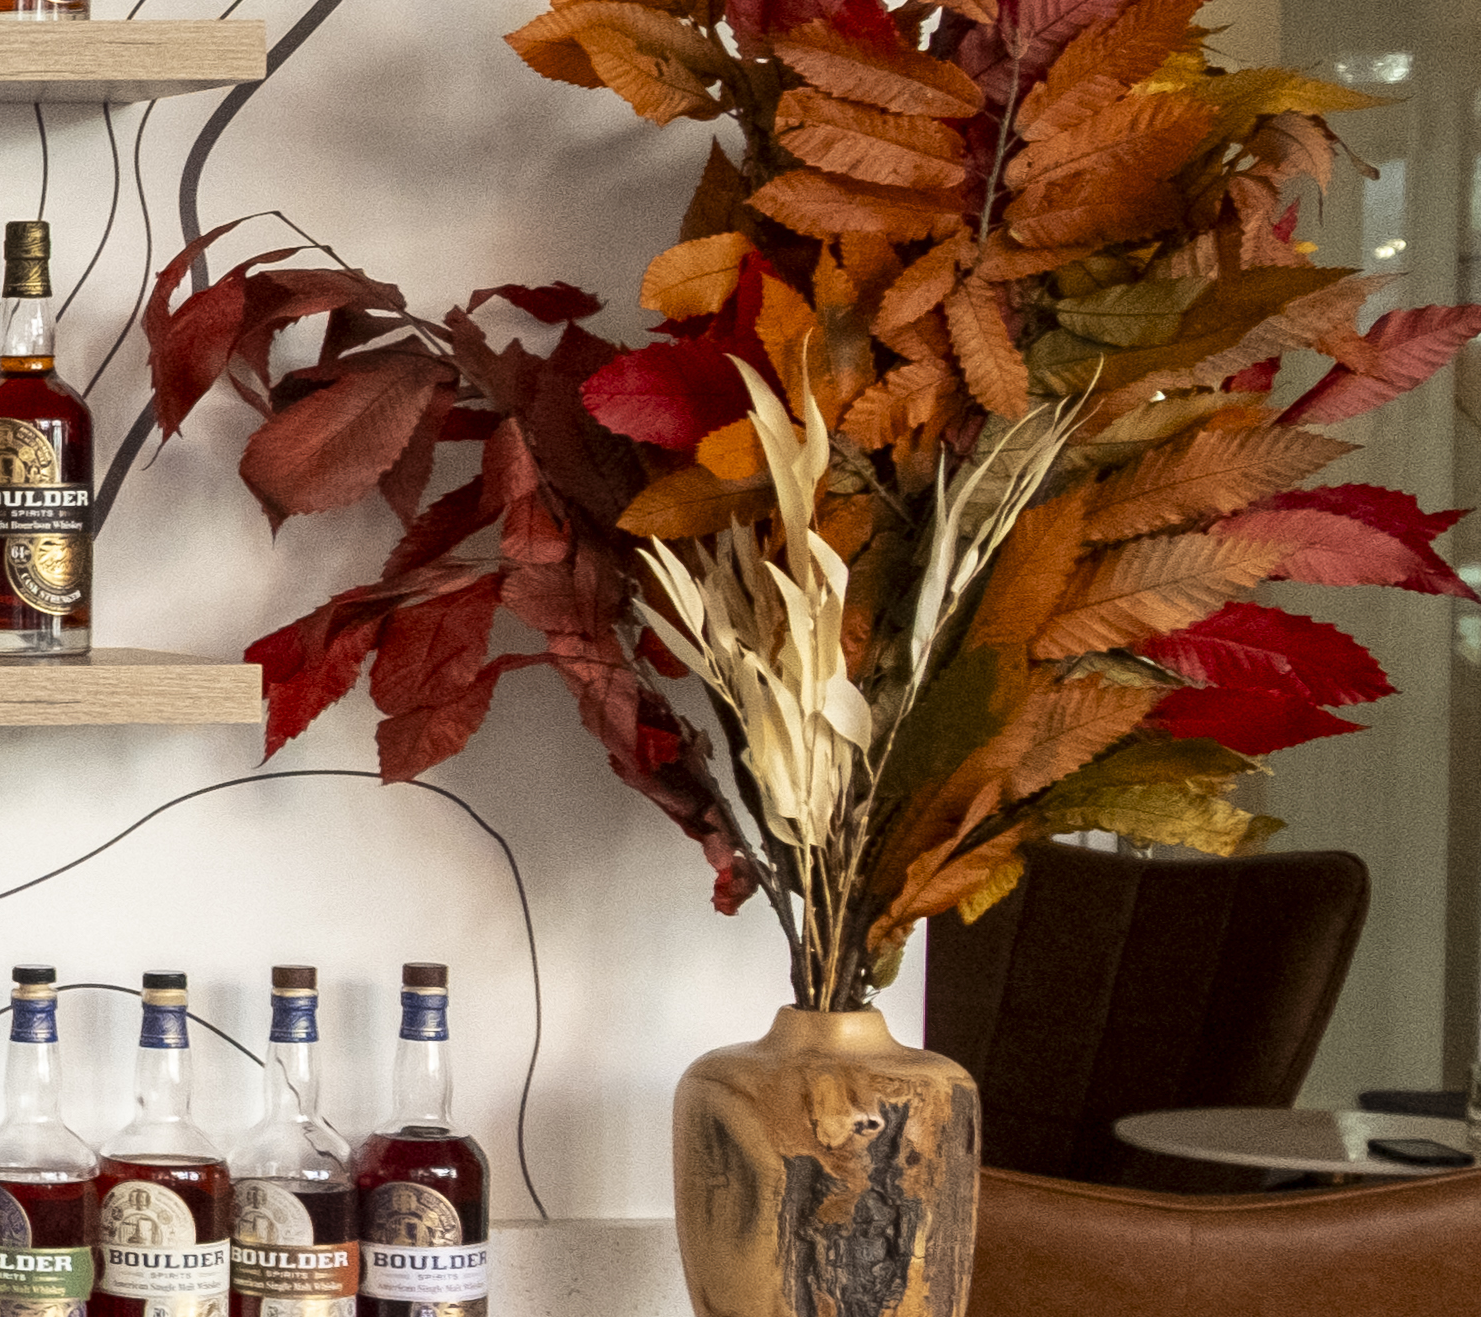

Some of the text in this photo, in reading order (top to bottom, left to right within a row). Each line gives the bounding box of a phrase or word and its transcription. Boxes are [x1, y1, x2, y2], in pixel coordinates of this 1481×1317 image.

[11, 510, 54, 518] SPIRITS
[11, 520, 51, 529] Bourbon
[109, 1249, 225, 1269] BOULDER
[231, 1249, 349, 1271] BOULDER
[374, 1250, 488, 1271] BOULDER
